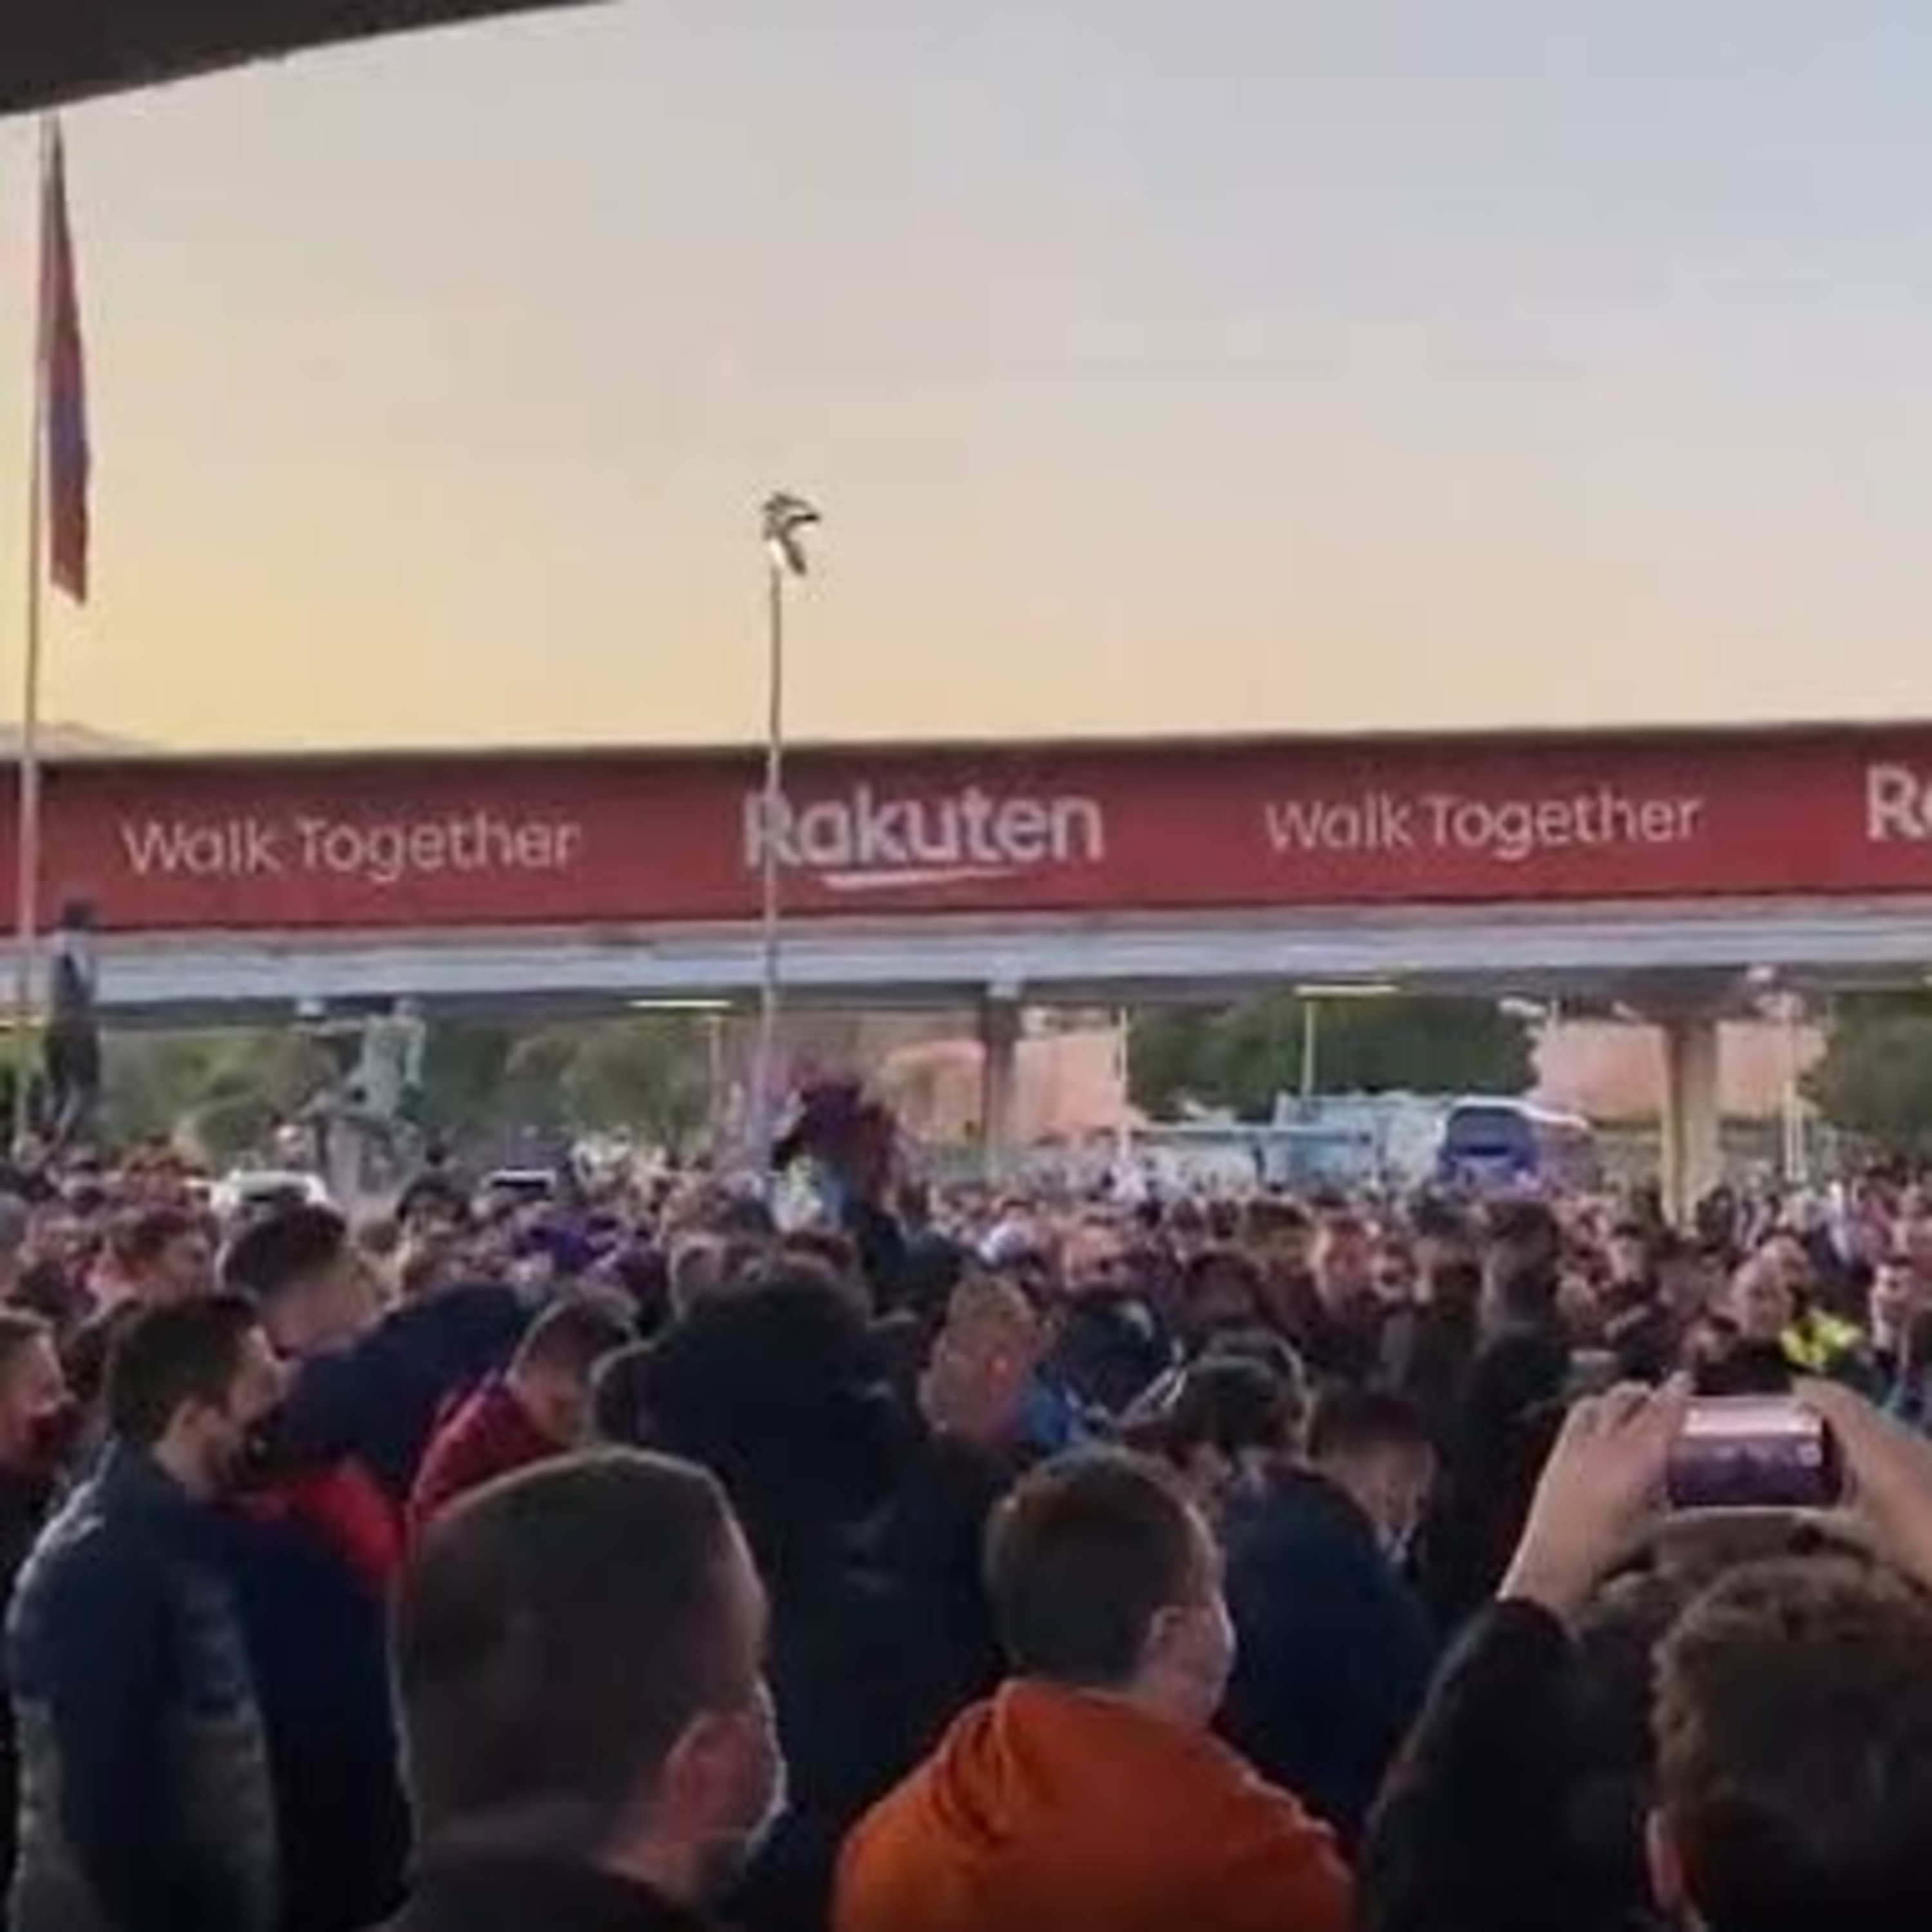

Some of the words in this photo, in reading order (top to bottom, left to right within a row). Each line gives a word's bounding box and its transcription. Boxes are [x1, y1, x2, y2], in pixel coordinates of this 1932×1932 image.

[743, 781, 1103, 867] Rakuten
[1266, 791, 1412, 851] Walk
[1421, 784, 1701, 861] Together
[1866, 762, 1932, 841] R
[122, 817, 281, 875] Walk
[297, 813, 582, 883] Together
